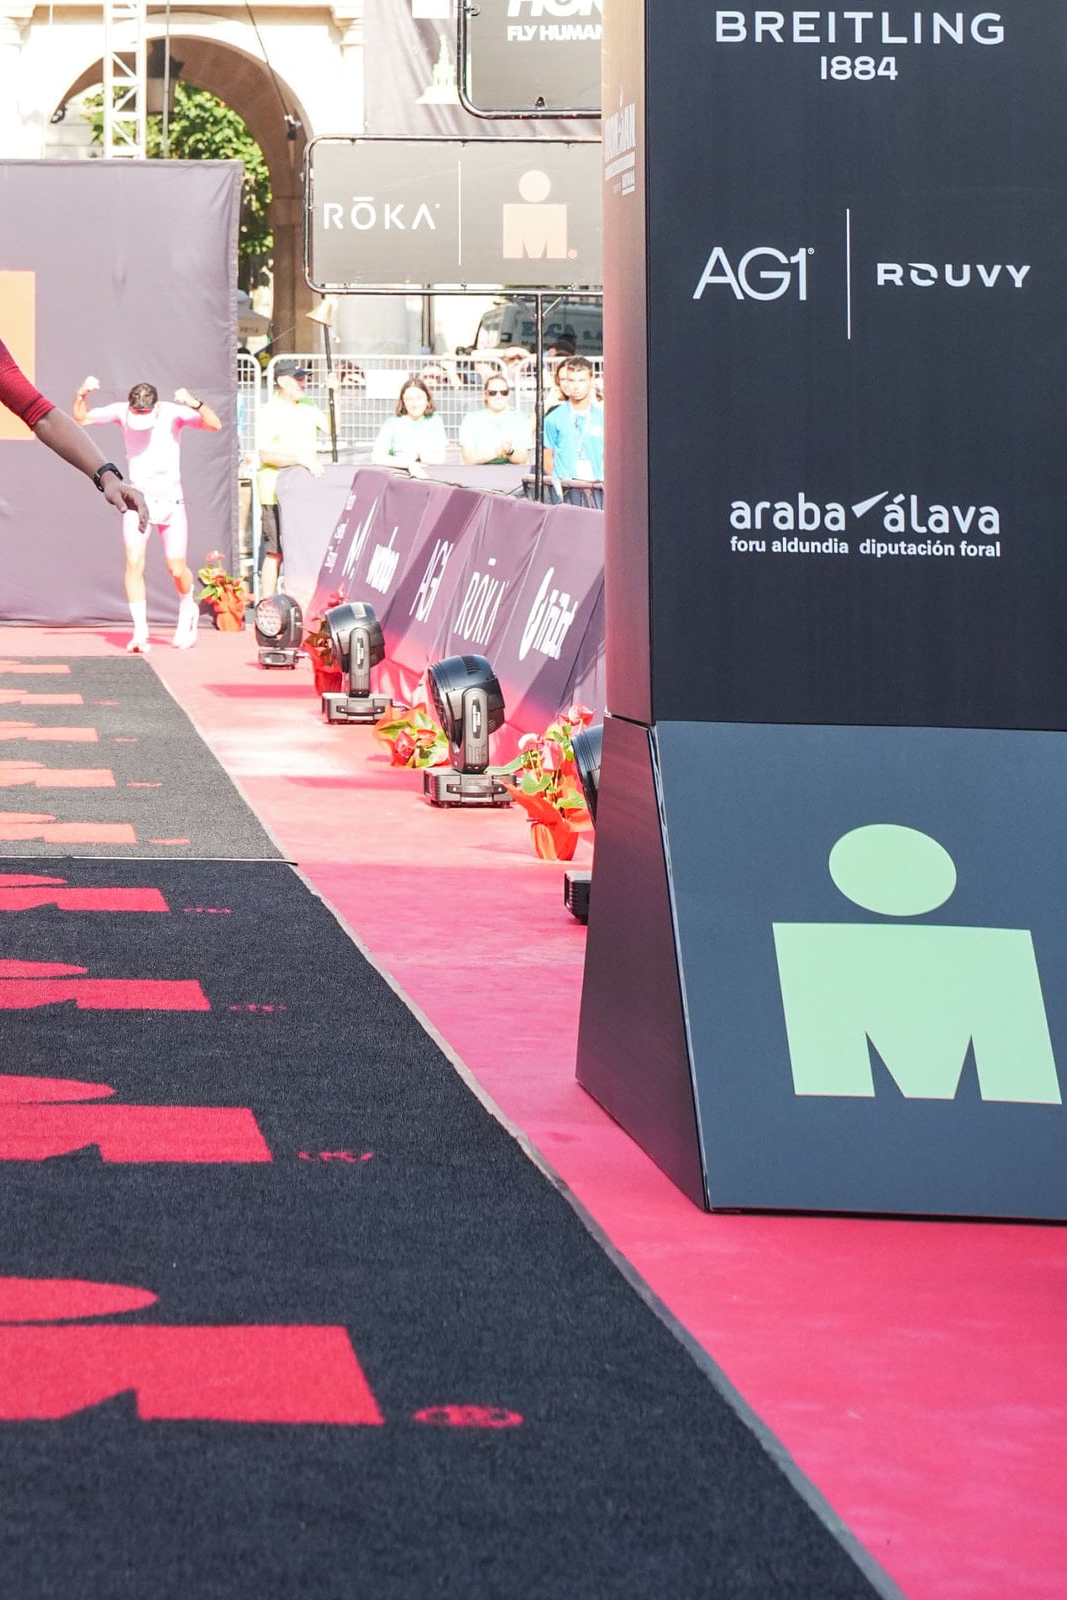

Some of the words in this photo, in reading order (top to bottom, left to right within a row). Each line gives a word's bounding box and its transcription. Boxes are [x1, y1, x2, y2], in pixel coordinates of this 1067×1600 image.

[507, 24, 537, 41] FLY
[715, 11, 1005, 45] BREITLING
[820, 55, 898, 81] 1884
[876, 262, 1031, 288] ROUVY
[729, 492, 846, 532] araba
[883, 493, 1000, 535] álava
[730, 536, 767, 553] foru
[772, 536, 849, 555] aldundia
[859, 539, 955, 559] diputación
[959, 539, 1001, 557] foral
